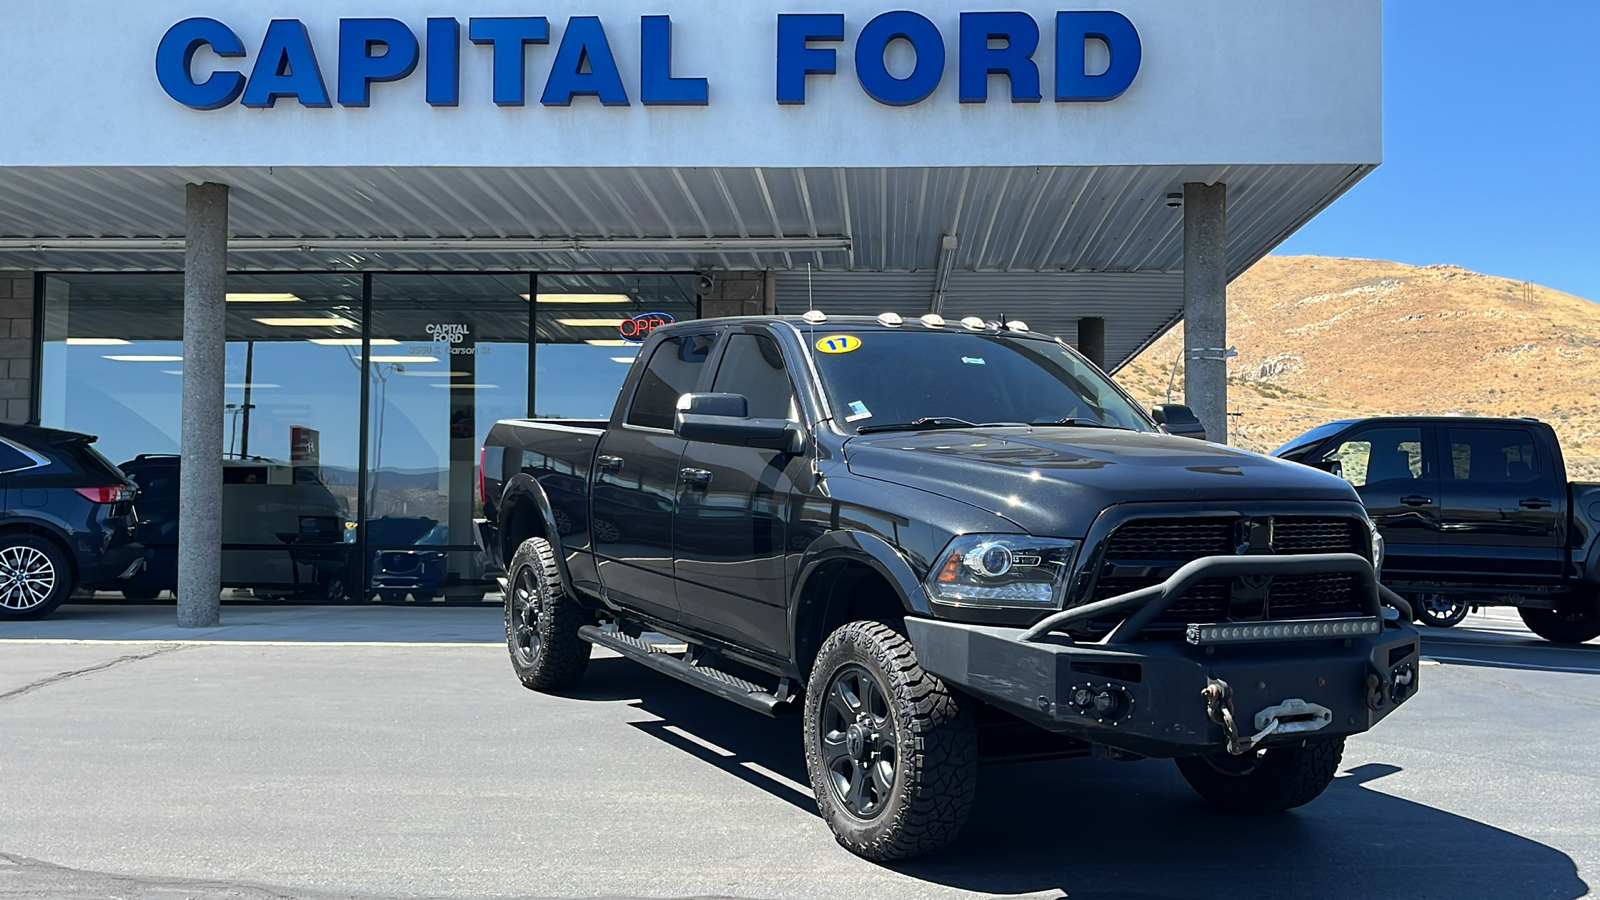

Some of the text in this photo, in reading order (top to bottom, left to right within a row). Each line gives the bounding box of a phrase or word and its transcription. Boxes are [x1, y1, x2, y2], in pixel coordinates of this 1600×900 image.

[156, 10, 1142, 110] CAPITAL FORD
[425, 324, 469, 334] CAPITAL
[433, 334, 463, 343] FORD
[826, 337, 847, 350] 17
